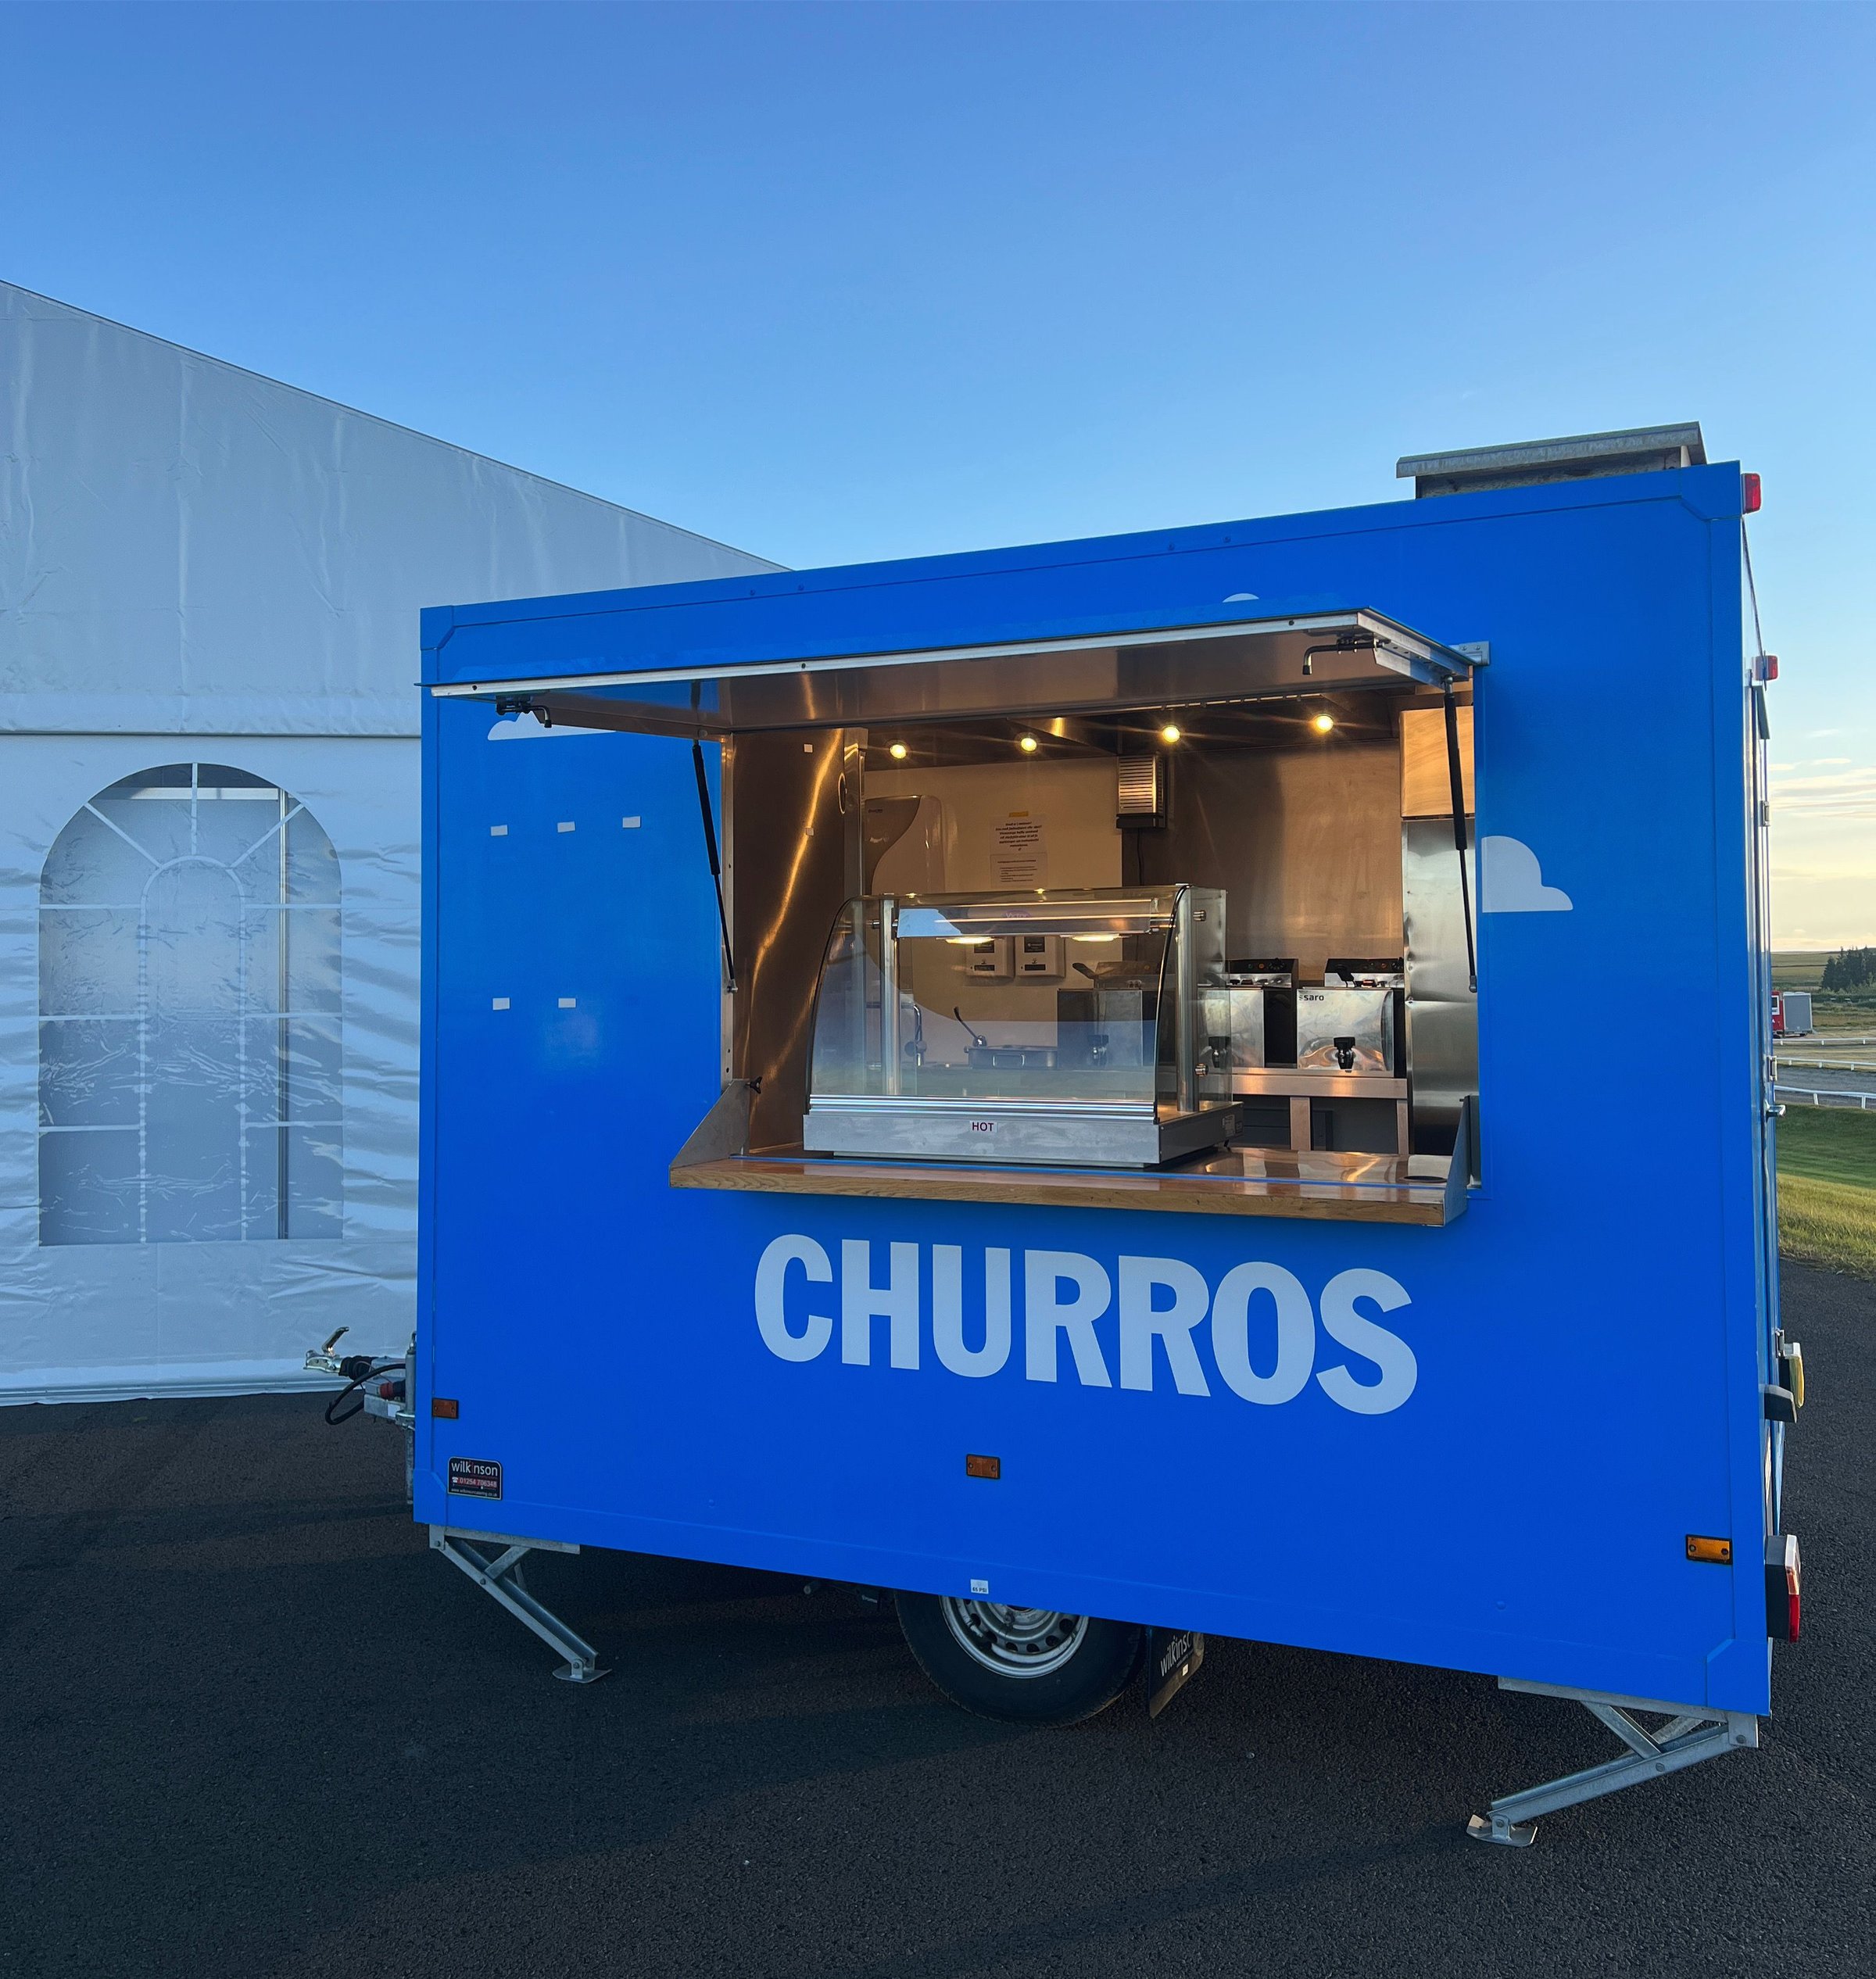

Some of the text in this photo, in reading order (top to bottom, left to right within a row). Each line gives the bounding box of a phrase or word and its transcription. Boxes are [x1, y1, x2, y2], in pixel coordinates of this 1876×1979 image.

[972, 1122, 994, 1132] HOT
[754, 1233, 1418, 1415] CHURROS
[1160, 1630, 1192, 1677] wilkinso
